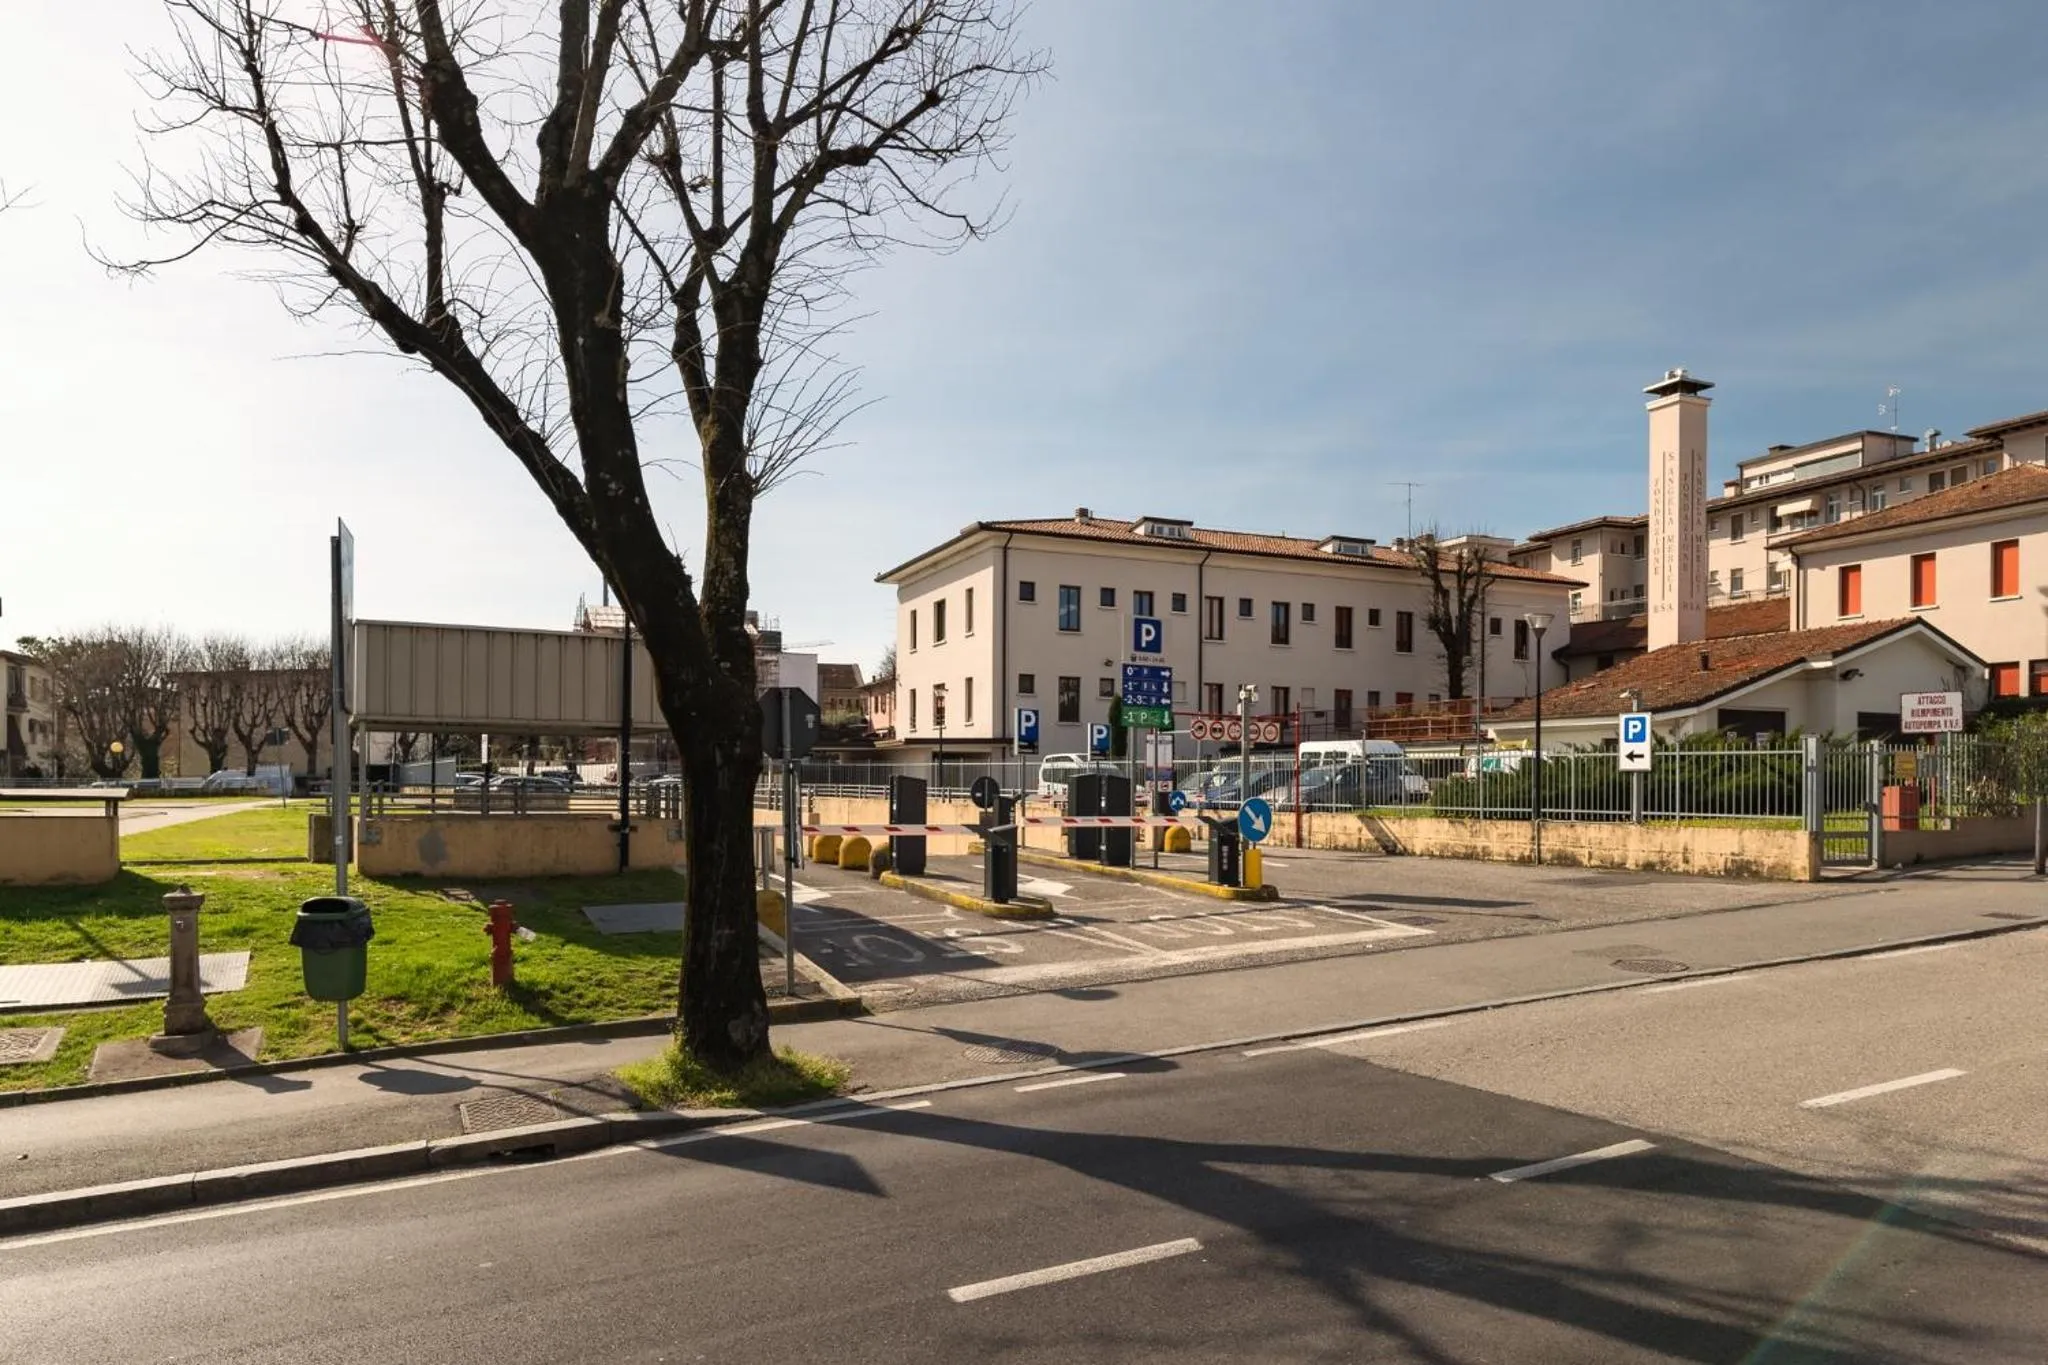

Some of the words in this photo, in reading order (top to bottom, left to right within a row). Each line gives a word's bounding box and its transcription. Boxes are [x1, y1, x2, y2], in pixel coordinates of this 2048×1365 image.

[1141, 623, 1156, 648] P
[1917, 695, 1946, 705] ATTACCO
[1911, 707, 1953, 717] RIEMPIMENTO
[1020, 709, 1036, 737] P
[1628, 719, 1642, 740] P
[1092, 724, 1108, 746] P
